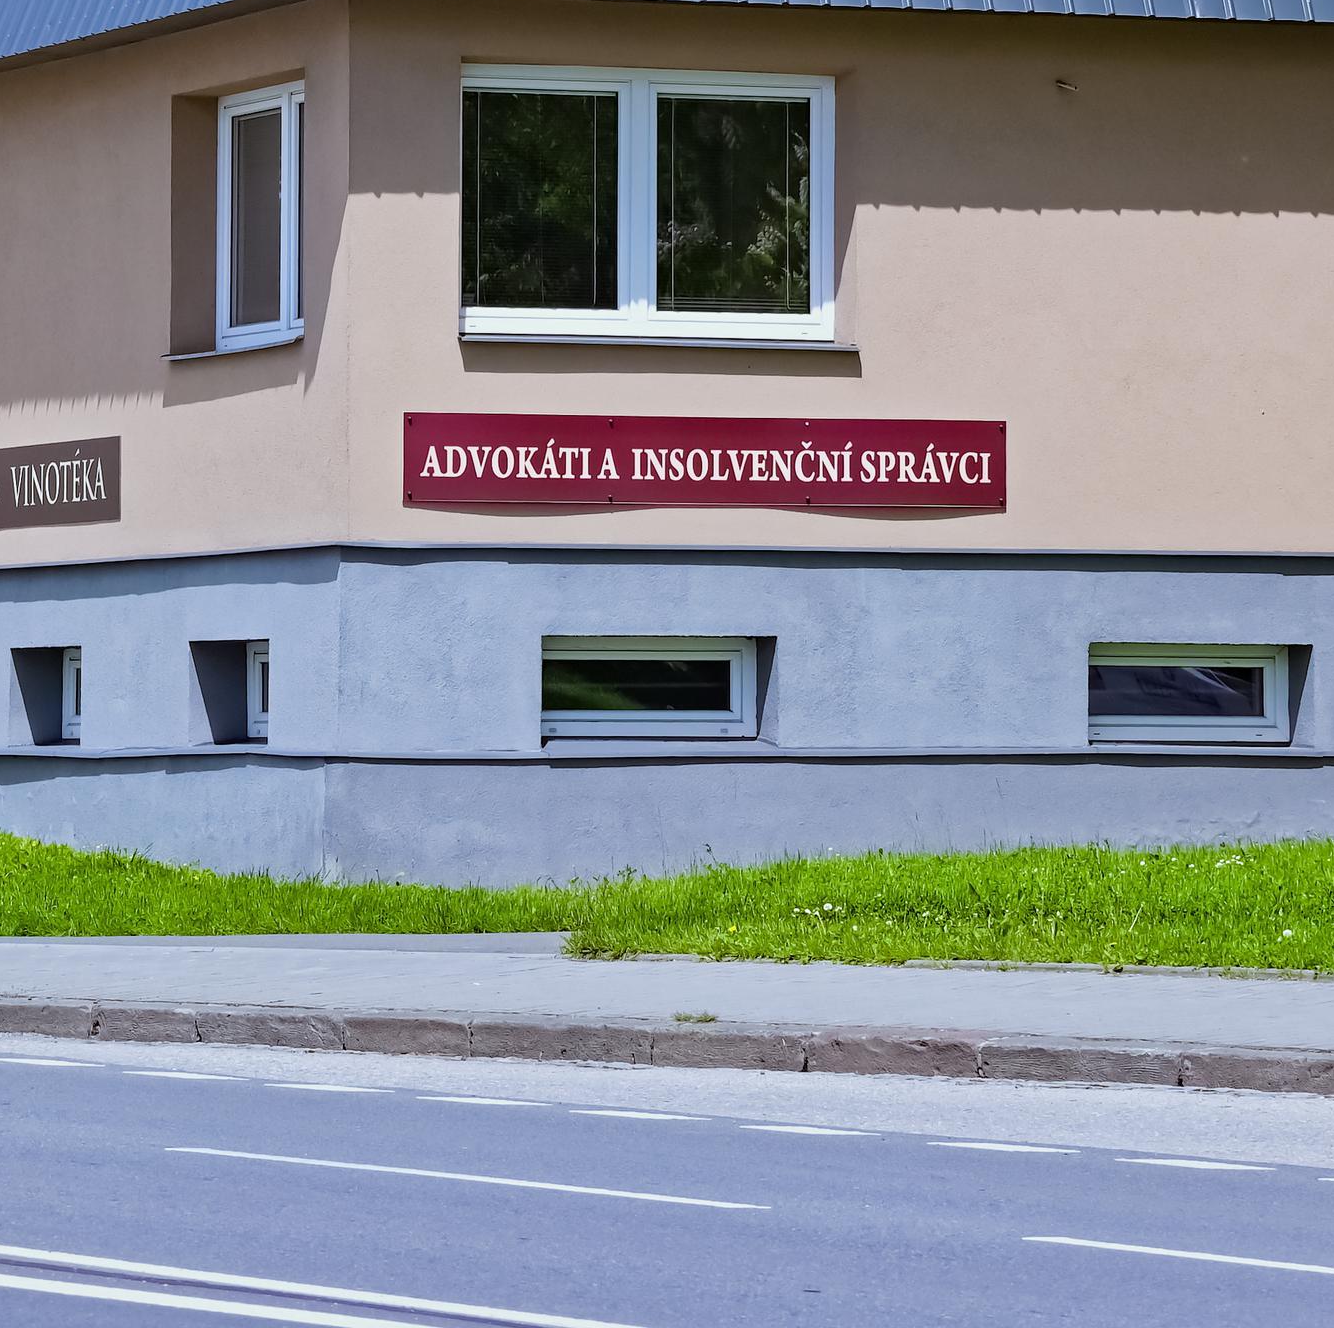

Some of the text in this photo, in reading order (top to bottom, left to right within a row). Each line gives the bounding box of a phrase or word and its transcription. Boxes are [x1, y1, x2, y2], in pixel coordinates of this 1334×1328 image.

[10, 448, 107, 507] VINOTÉKA
[419, 438, 992, 484] ADVOKÁTI A INSOLVENČNÍ SPRÁVCI
